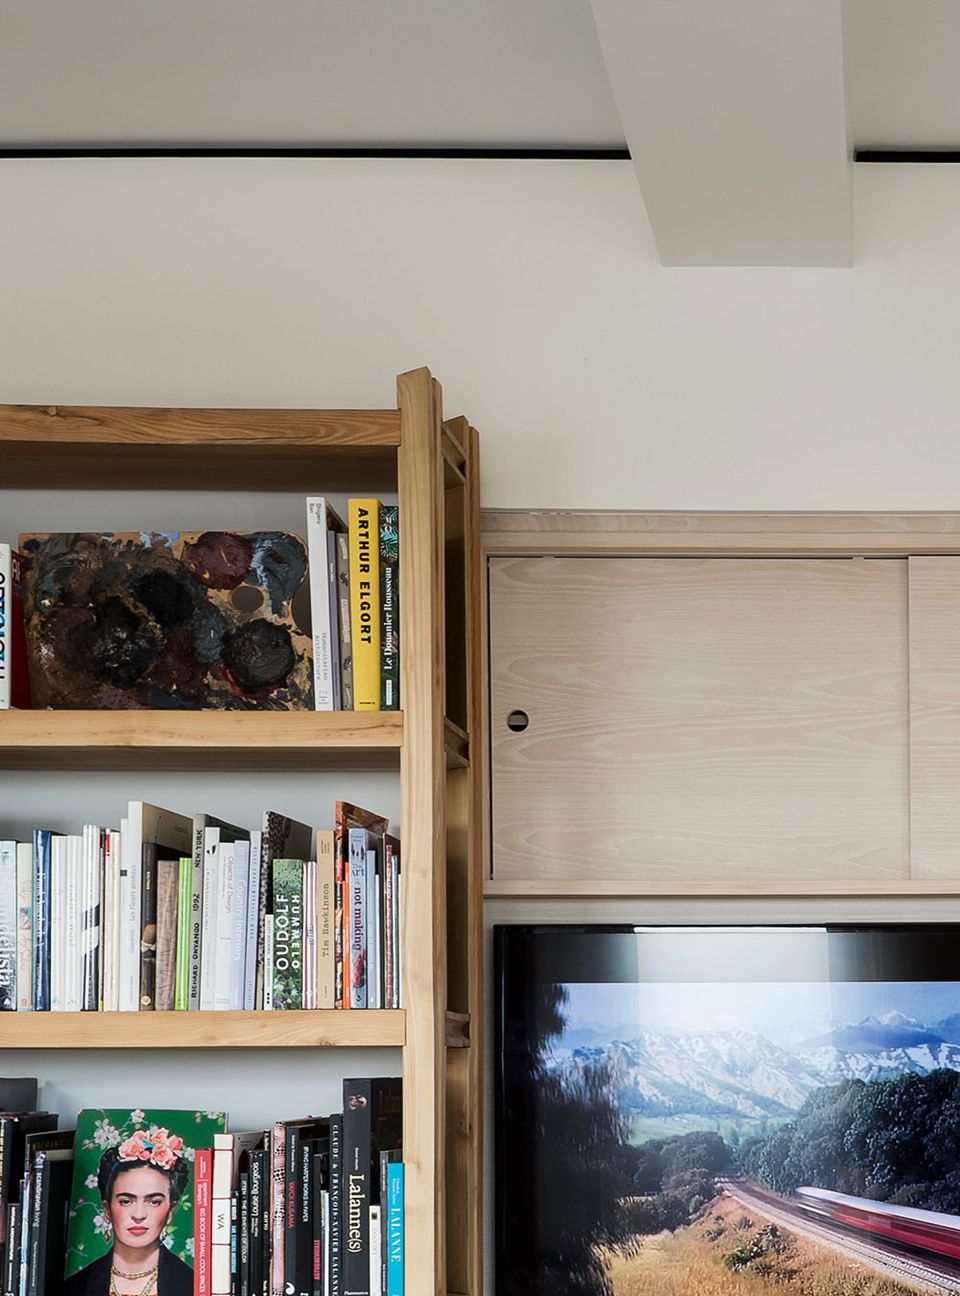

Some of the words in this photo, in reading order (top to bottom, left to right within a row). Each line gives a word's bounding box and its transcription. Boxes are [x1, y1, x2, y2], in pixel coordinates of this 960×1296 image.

[358, 507, 370, 574] ARTHUR
[382, 567, 393, 611] Rousseau
[360, 581, 372, 645] ELGORT
[383, 611, 393, 656] Douanier
[383, 656, 393, 670] Le
[192, 893, 200, 912] 1992
[233, 879, 245, 918] Country
[354, 887, 363, 906] not
[192, 922, 200, 960] ONYANGO
[234, 919, 244, 961] Interiors
[276, 893, 289, 971] OUDOLF
[291, 894, 300, 970] HUMMELO
[353, 907, 363, 951] making
[191, 965, 199, 998] RICHARD
[301, 1146, 309, 1162] IRVING
[301, 1162, 309, 1183] HARPER
[34, 1172, 44, 1211] scandinavian
[251, 1161, 261, 1195] Bourgeois
[301, 1183, 309, 1200] WORKS
[32, 1211, 42, 1228] living
[217, 1213, 225, 1230] WA
[251, 1195, 259, 1216] Louise
[331, 1173, 339, 1253] FRANÇOIS-XAVIER
[346, 1174, 366, 1253] Lalanne(s)
[391, 1207, 402, 1263] LALANNE
